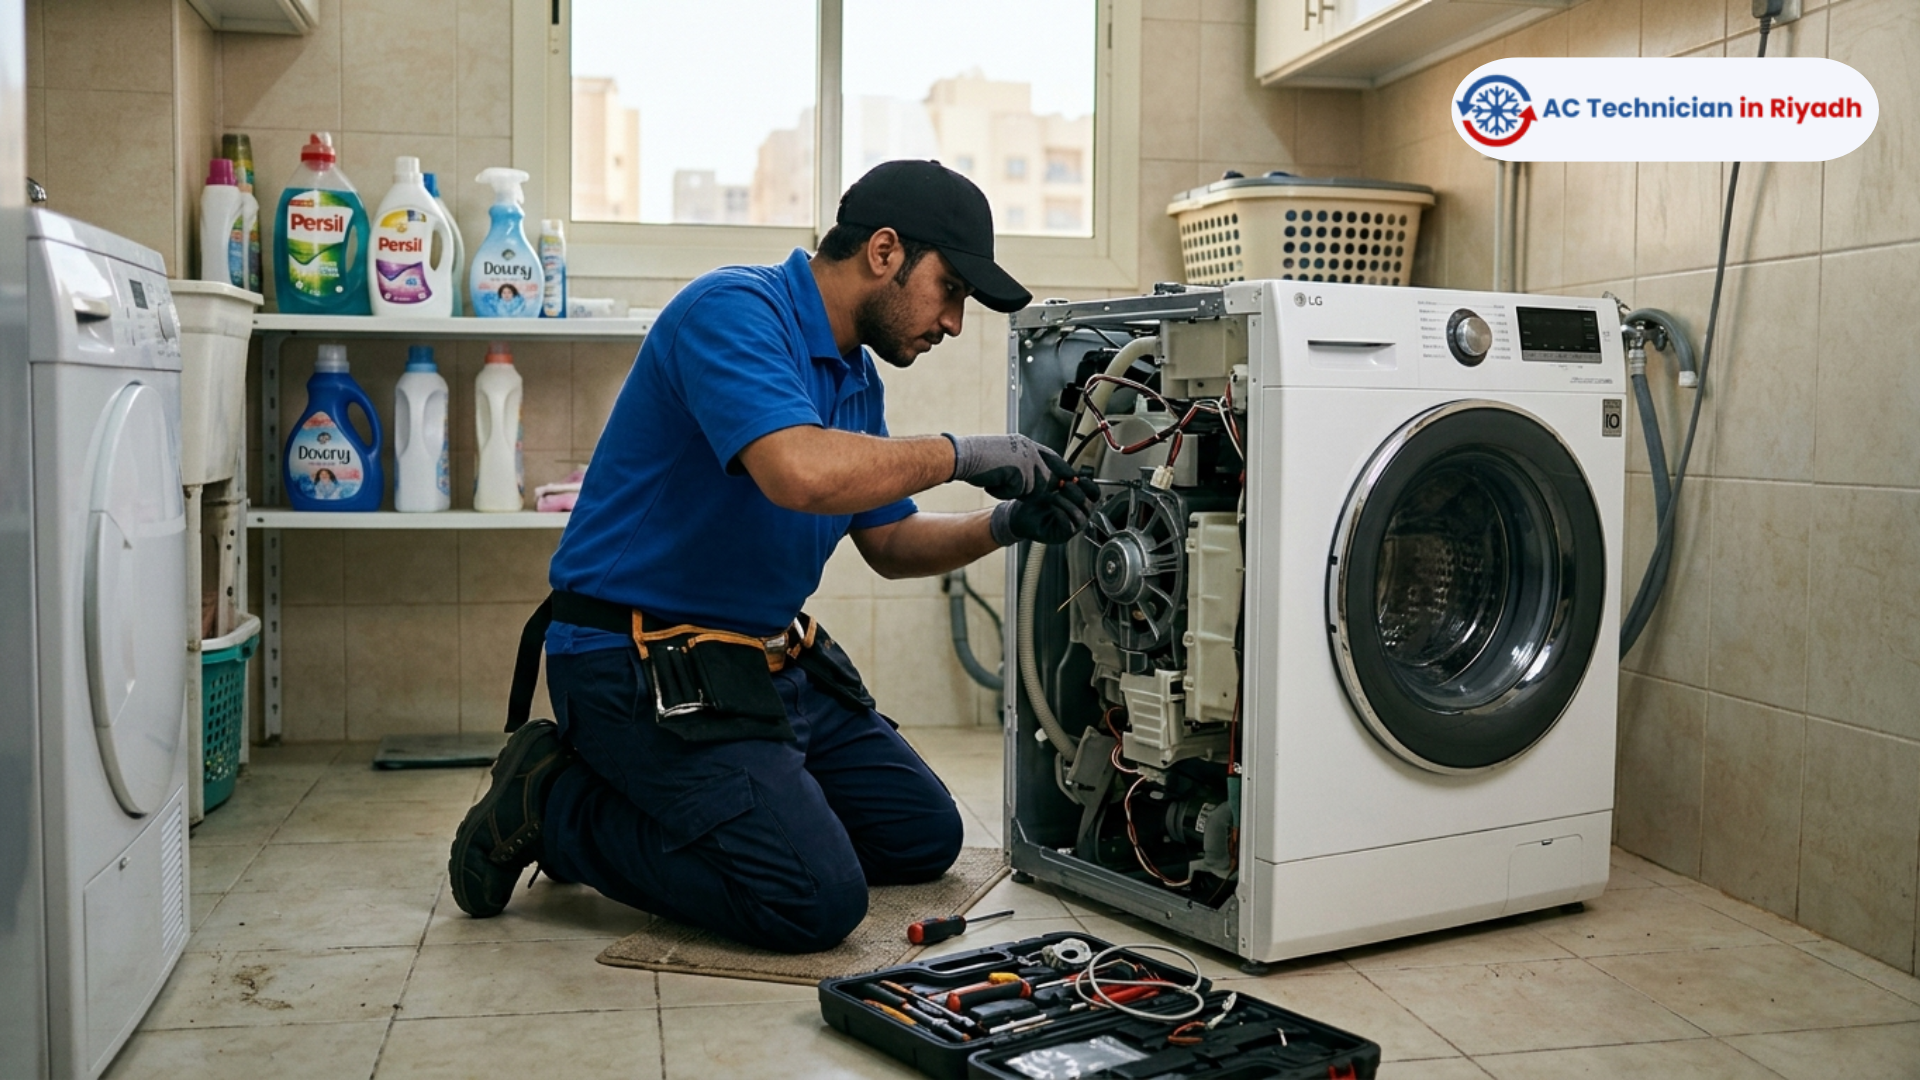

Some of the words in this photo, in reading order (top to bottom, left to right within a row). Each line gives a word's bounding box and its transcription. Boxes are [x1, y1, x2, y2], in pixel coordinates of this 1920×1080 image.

[291, 213, 344, 233] Persil
[378, 236, 422, 252] Persil
[1308, 296, 1323, 306] LG
